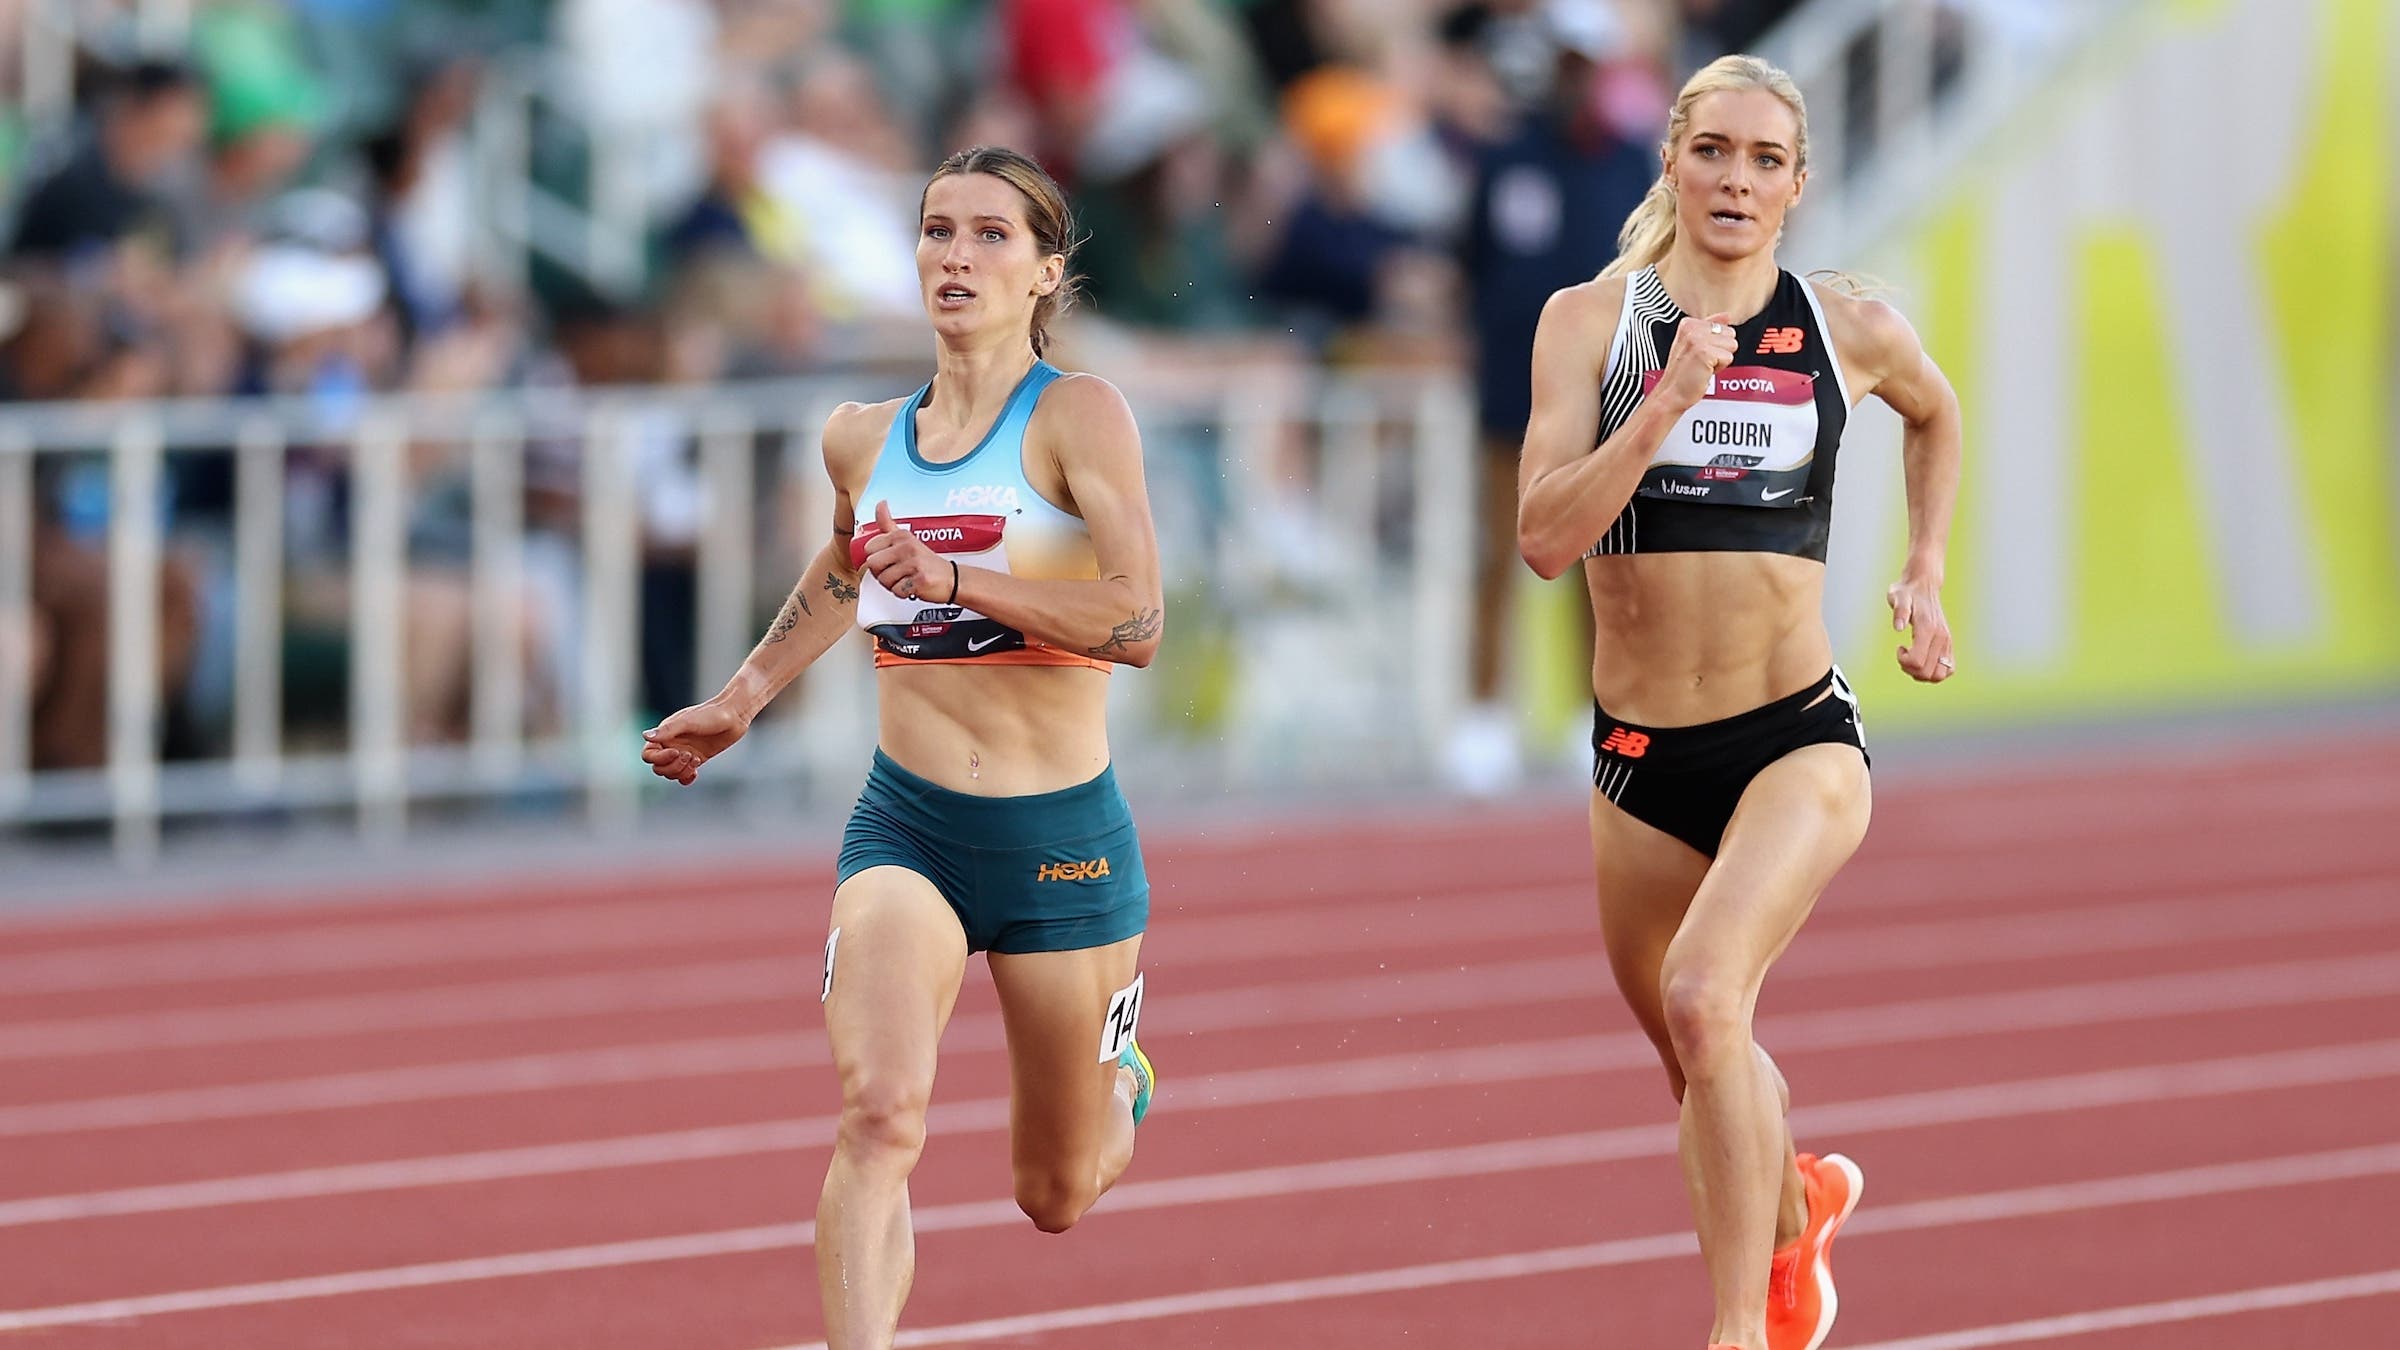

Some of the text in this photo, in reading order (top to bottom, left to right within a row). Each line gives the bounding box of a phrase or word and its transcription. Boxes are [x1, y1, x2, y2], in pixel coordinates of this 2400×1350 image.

[1756, 327, 1805, 354] NB
[1719, 379, 1776, 394] TOYOTA
[1691, 419, 1773, 448] COBURN
[944, 485, 1019, 508] HOKA
[1675, 484, 1710, 497] USATF
[914, 528, 964, 542] TOYOTA
[1600, 727, 1651, 758] NB
[1037, 857, 1111, 882] HOKA
[1110, 986, 1139, 1053] 14
